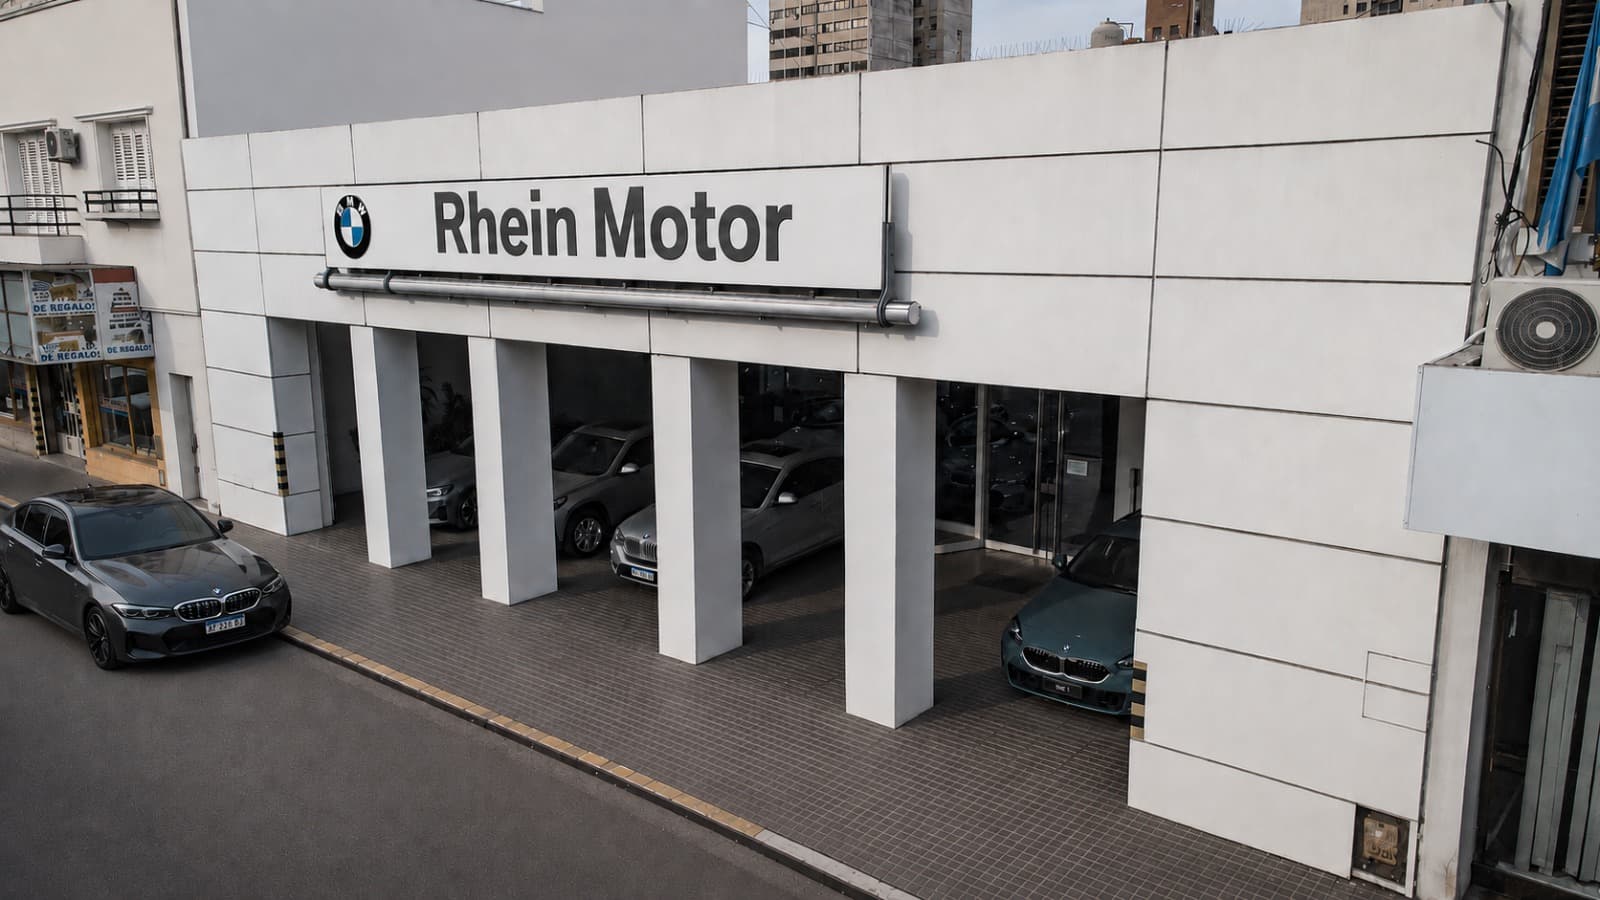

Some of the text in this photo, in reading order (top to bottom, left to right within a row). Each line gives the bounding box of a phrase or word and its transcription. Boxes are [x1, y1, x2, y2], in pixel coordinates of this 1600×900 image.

[434, 186, 793, 263] Rhein Motor
[33, 304, 47, 313] DE
[50, 302, 95, 312] REGALO!
[107, 346, 118, 354] DE
[41, 350, 101, 362] DE REGALO!
